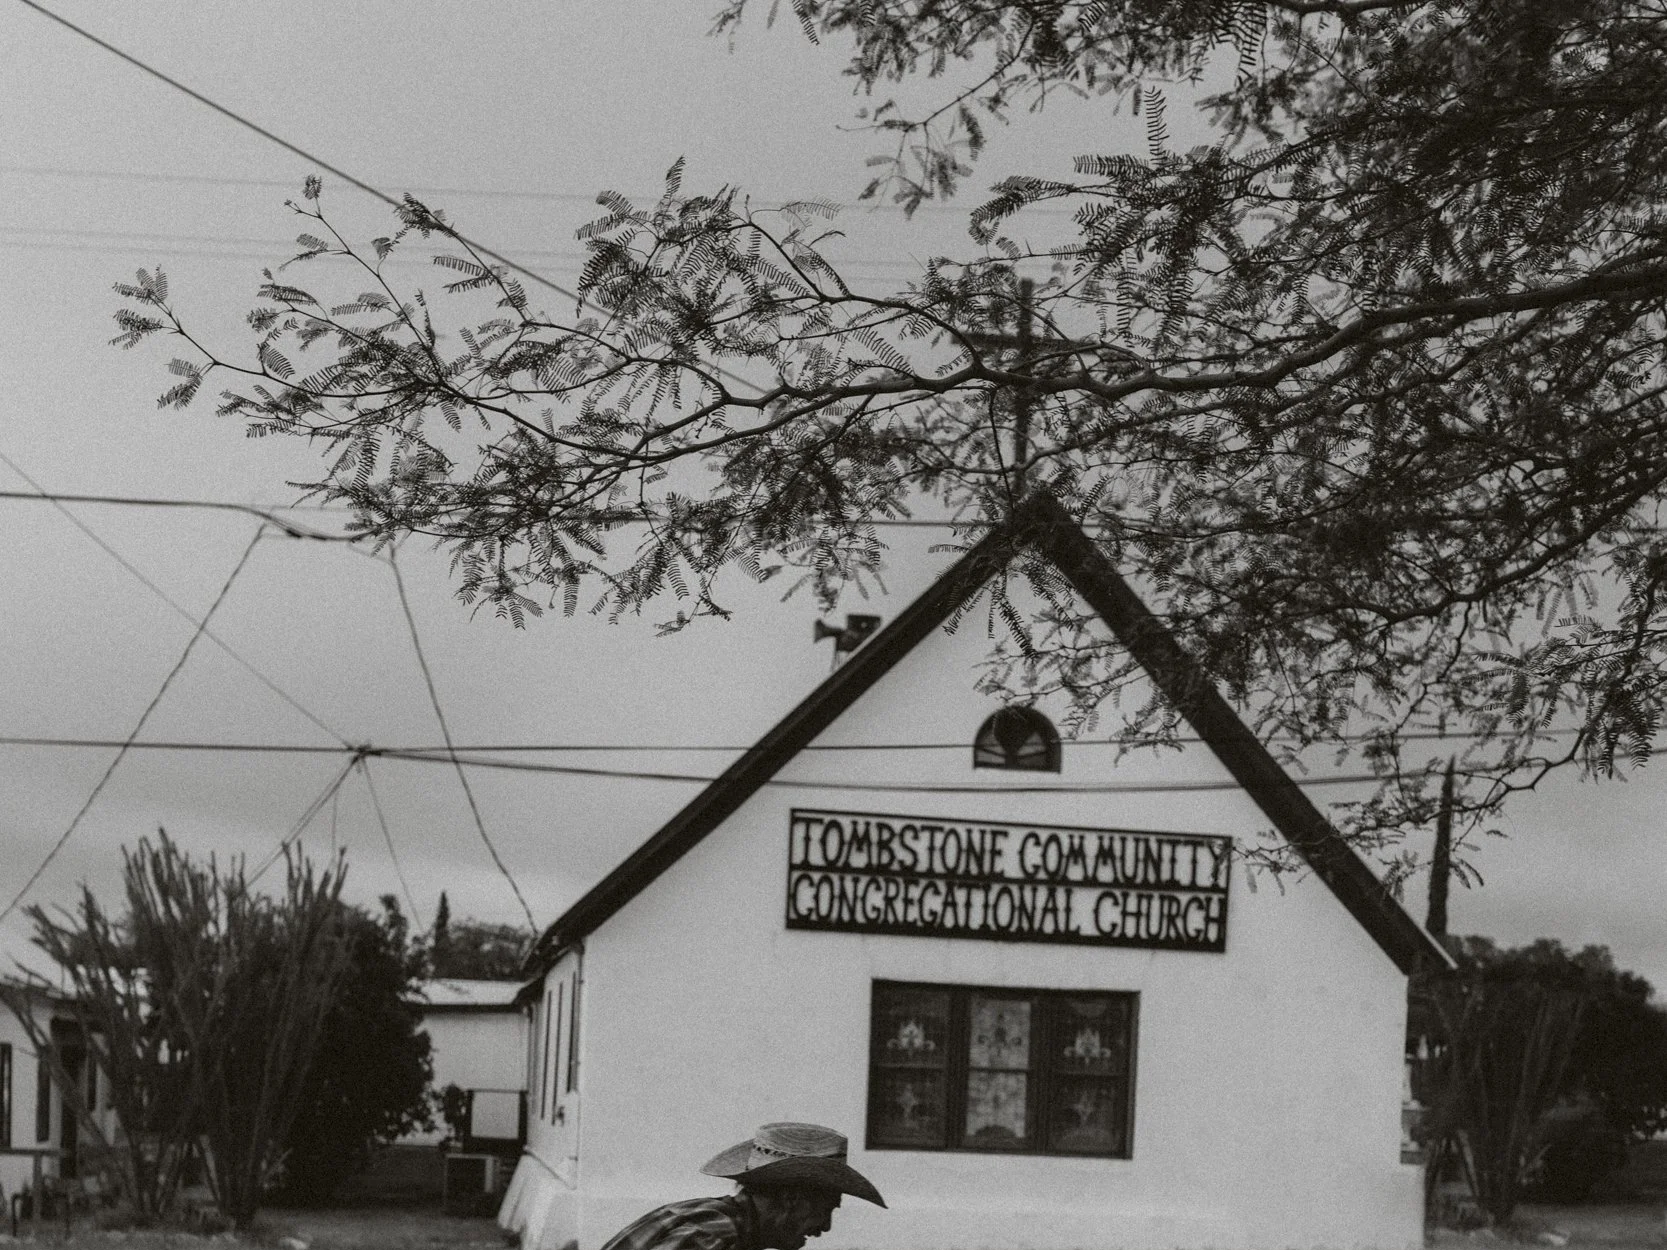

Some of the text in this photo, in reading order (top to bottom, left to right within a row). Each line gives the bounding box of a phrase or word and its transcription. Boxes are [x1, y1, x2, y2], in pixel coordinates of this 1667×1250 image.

[796, 817, 1226, 888] TOMBSTONE COMMUNITY
[792, 874, 1225, 942] CONGREGATIONAL CHURCH
